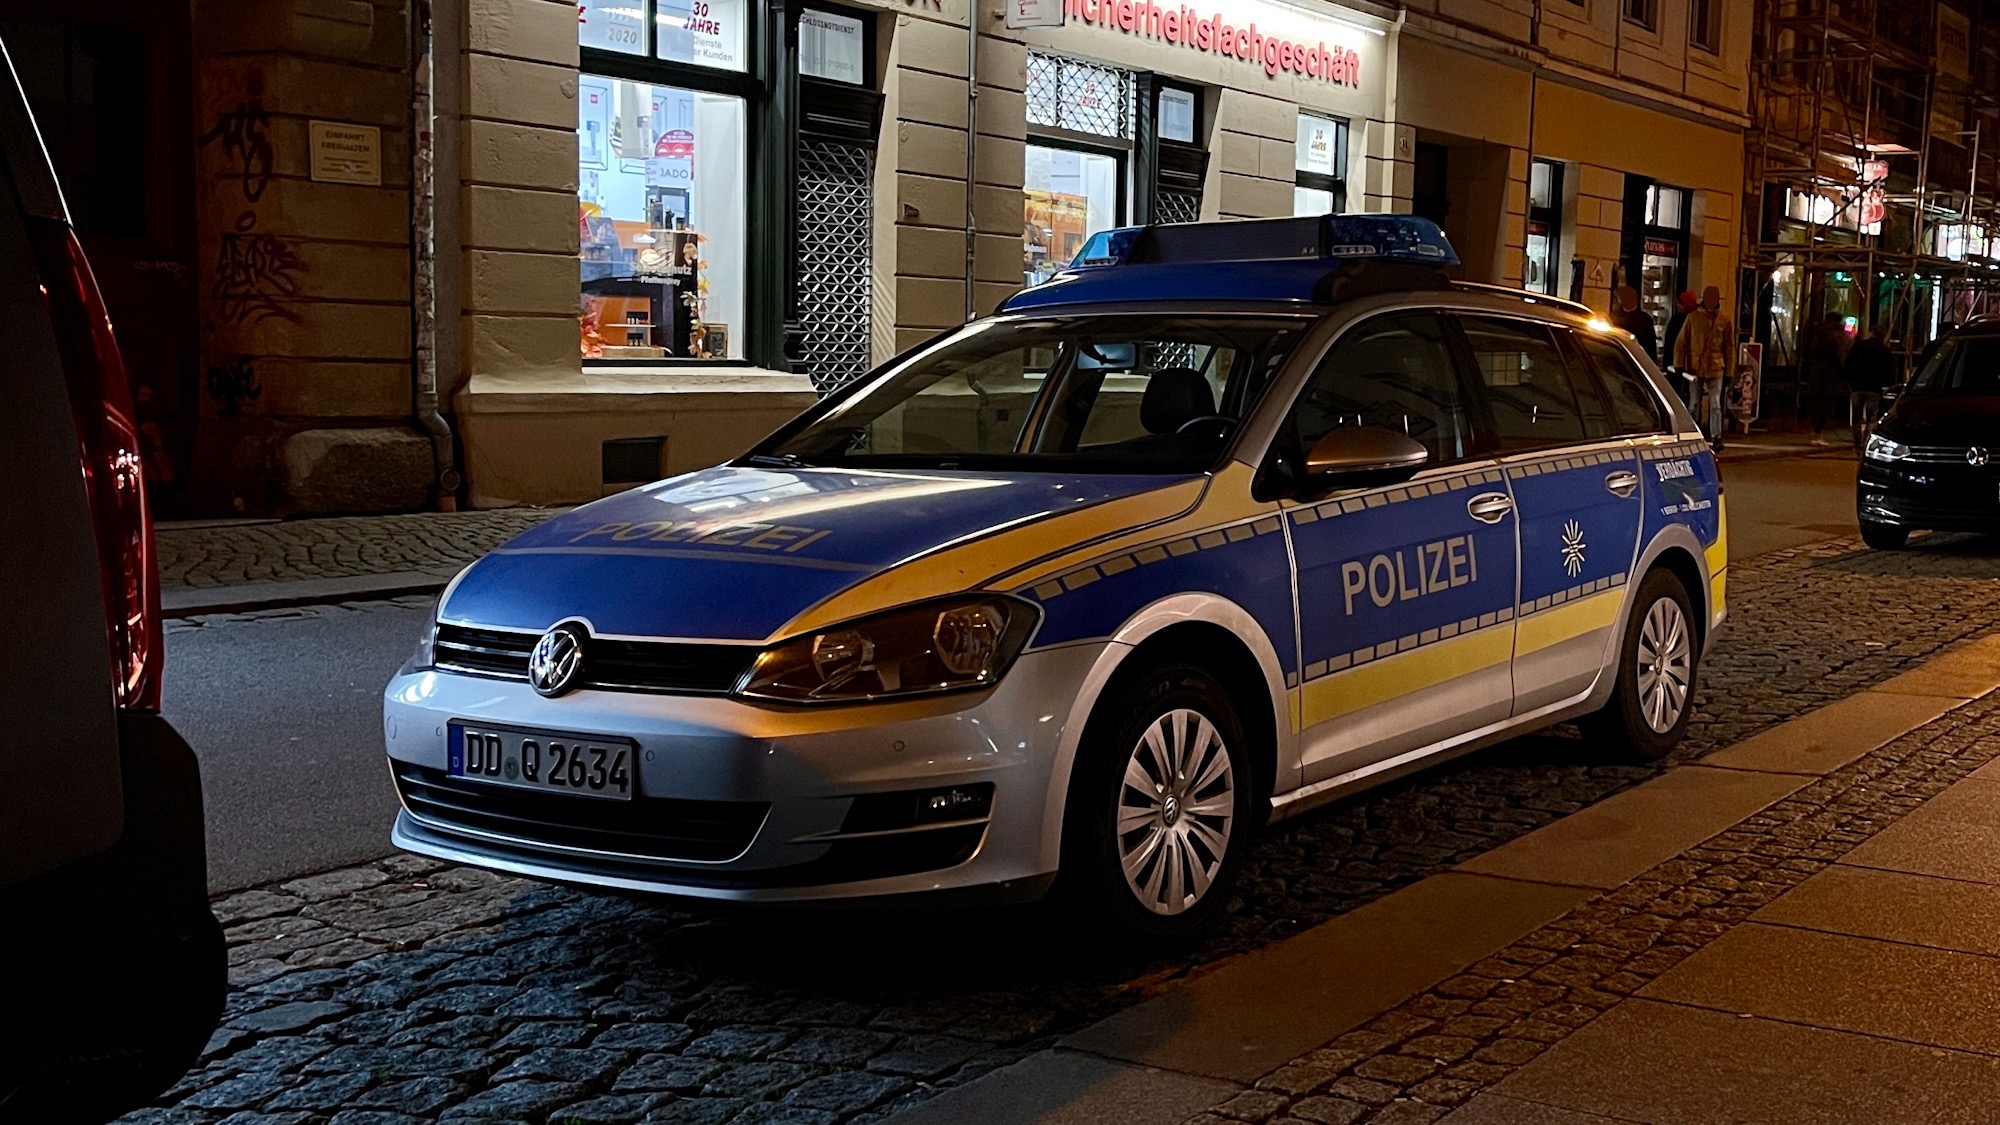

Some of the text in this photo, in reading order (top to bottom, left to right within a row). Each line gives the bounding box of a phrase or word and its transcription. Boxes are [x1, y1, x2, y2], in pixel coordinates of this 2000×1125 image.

[693, 1, 709, 18] 30
[683, 16, 721, 36] JAHRE
[608, 27, 637, 45] 2020
[693, 35, 722, 49] Dienste
[1065, 0, 1360, 86] cherheitsfachgeschäft
[703, 48, 733, 62] Kunden
[326, 131, 365, 141] EINFAHRT
[321, 142, 370, 153] FREIHALTEN
[660, 168, 688, 179] JADO
[567, 520, 834, 553] POLIZEI
[1341, 533, 1477, 616] POLIZEI
[452, 756, 460, 768] D
[465, 731, 628, 793] DD Q 2634
